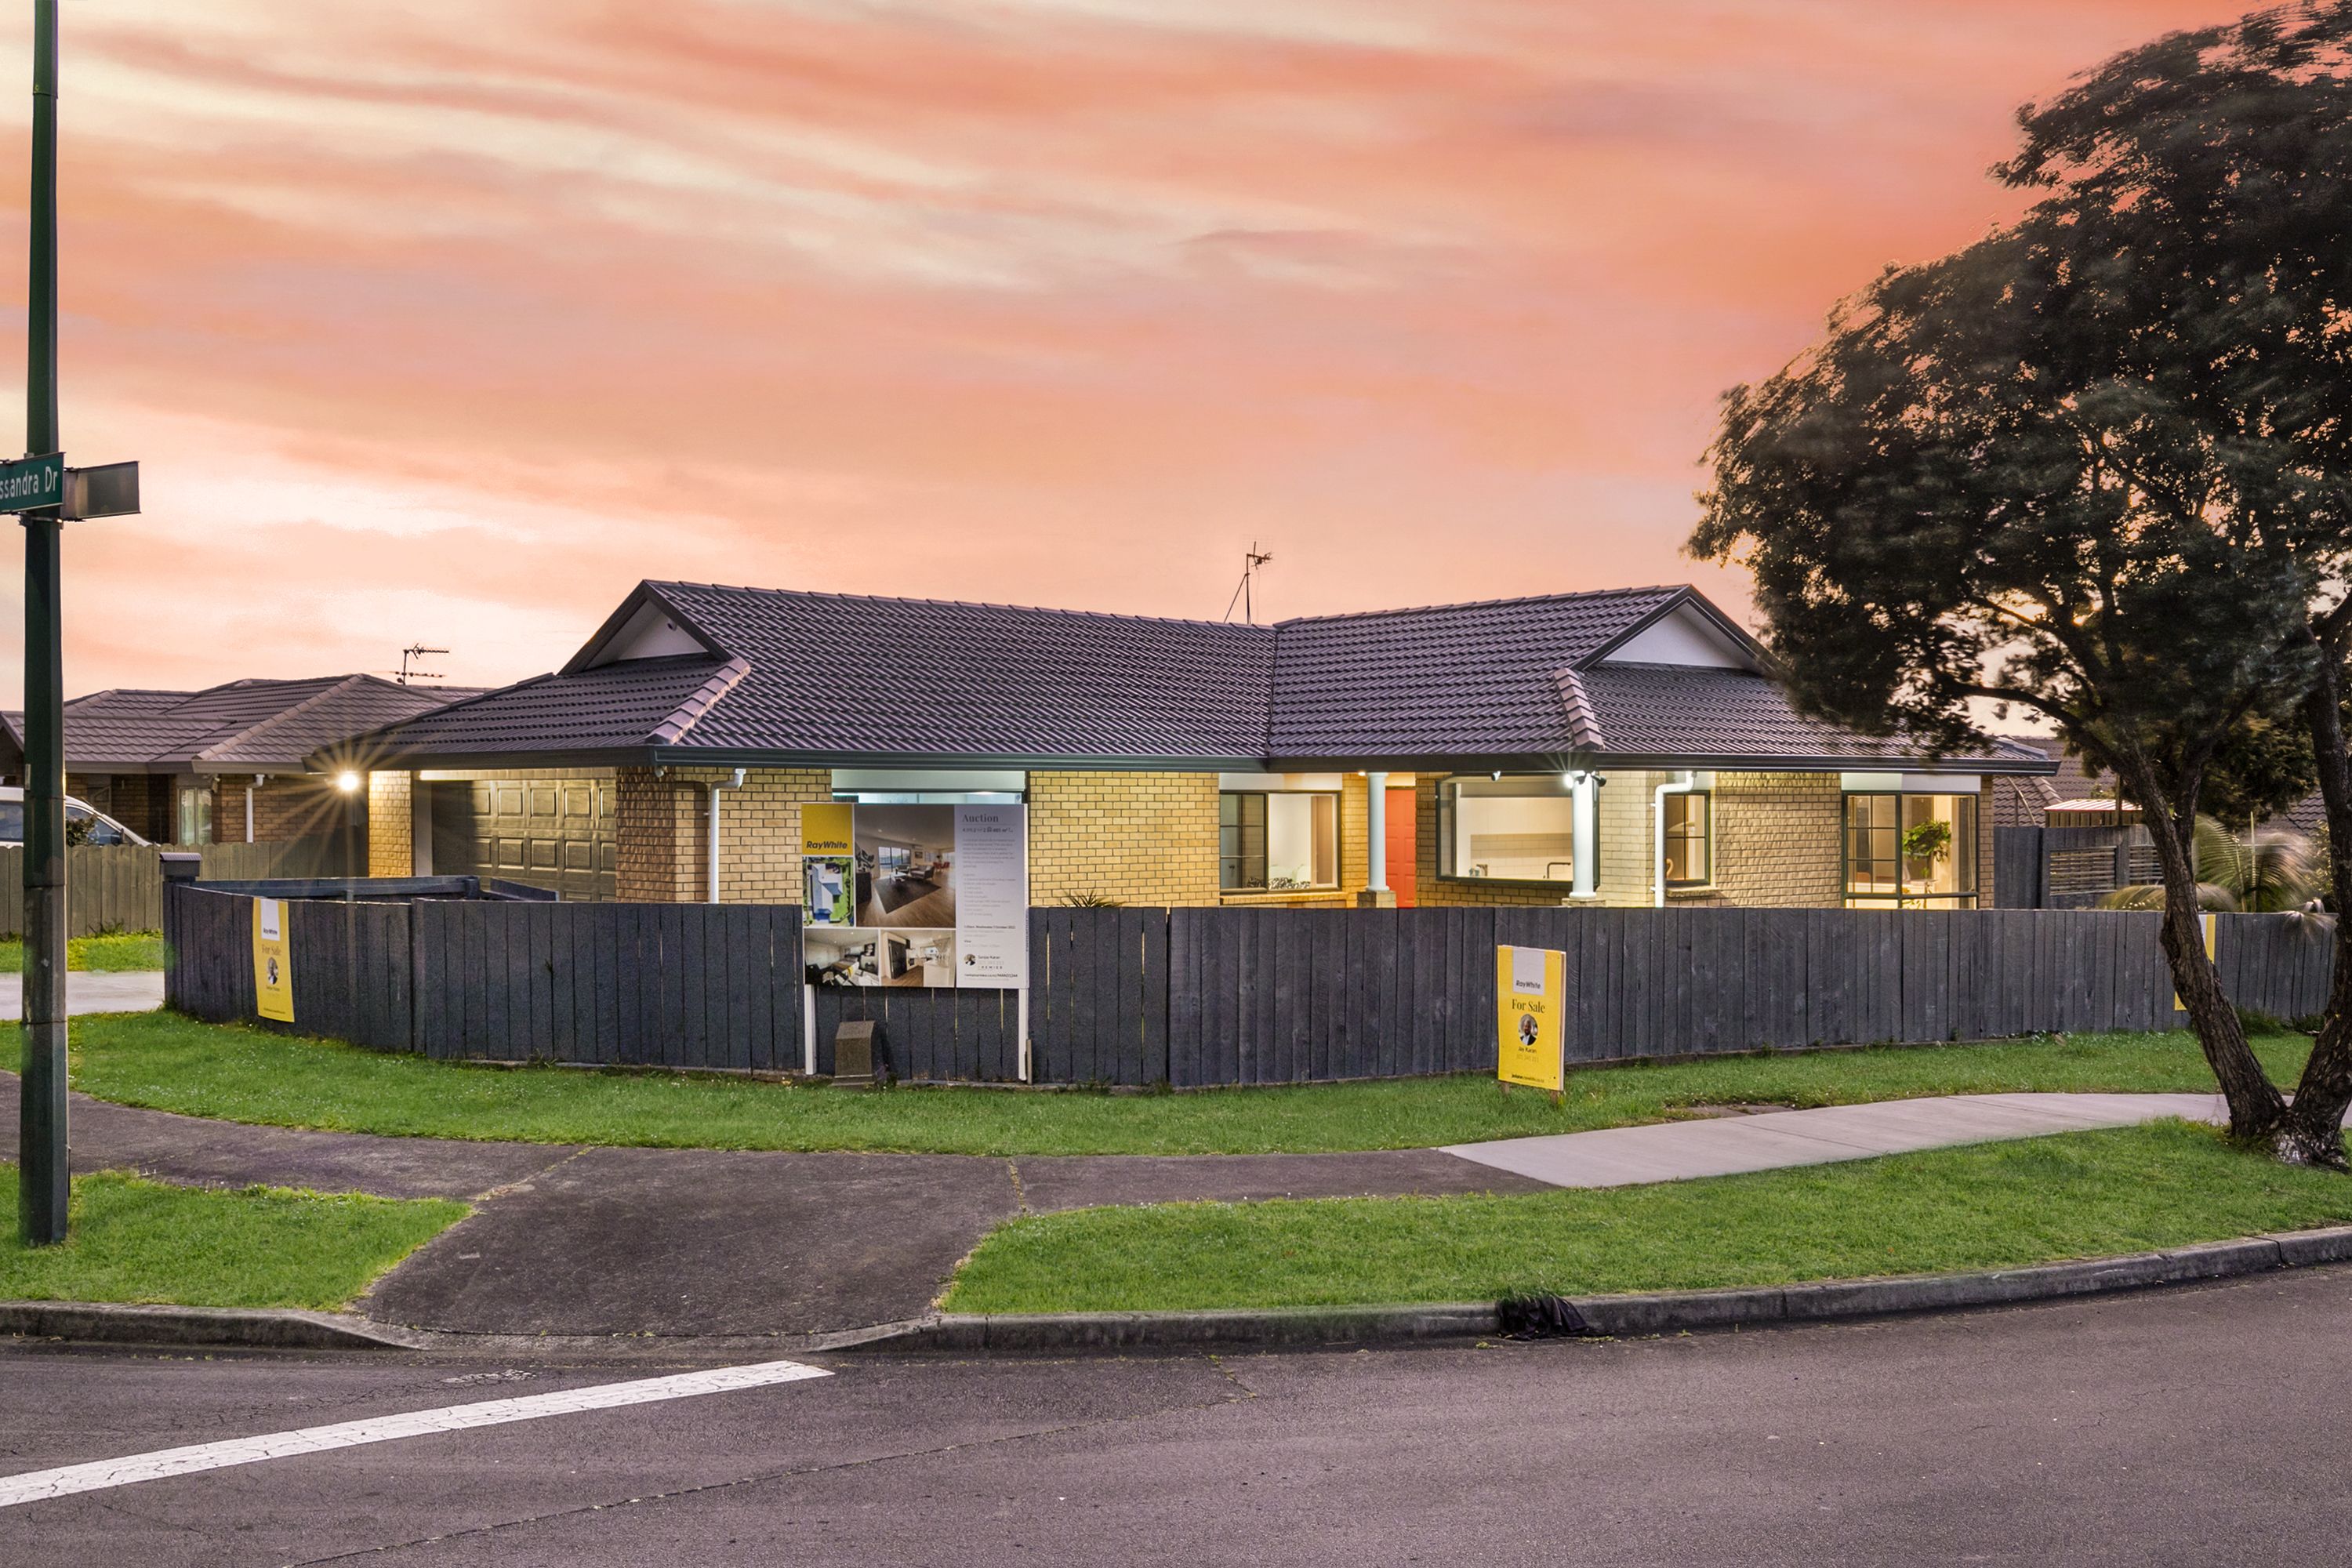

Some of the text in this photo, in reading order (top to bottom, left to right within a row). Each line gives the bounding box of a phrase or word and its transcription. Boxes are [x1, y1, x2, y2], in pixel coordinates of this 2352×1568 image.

[45, 466, 58, 492] Dr
[962, 813, 999, 822] Auction
[806, 840, 848, 850] RayWhite
[261, 944, 281, 956] For Sale
[1515, 980, 1541, 989] RayWhite
[1512, 999, 1545, 1014] For Sale
